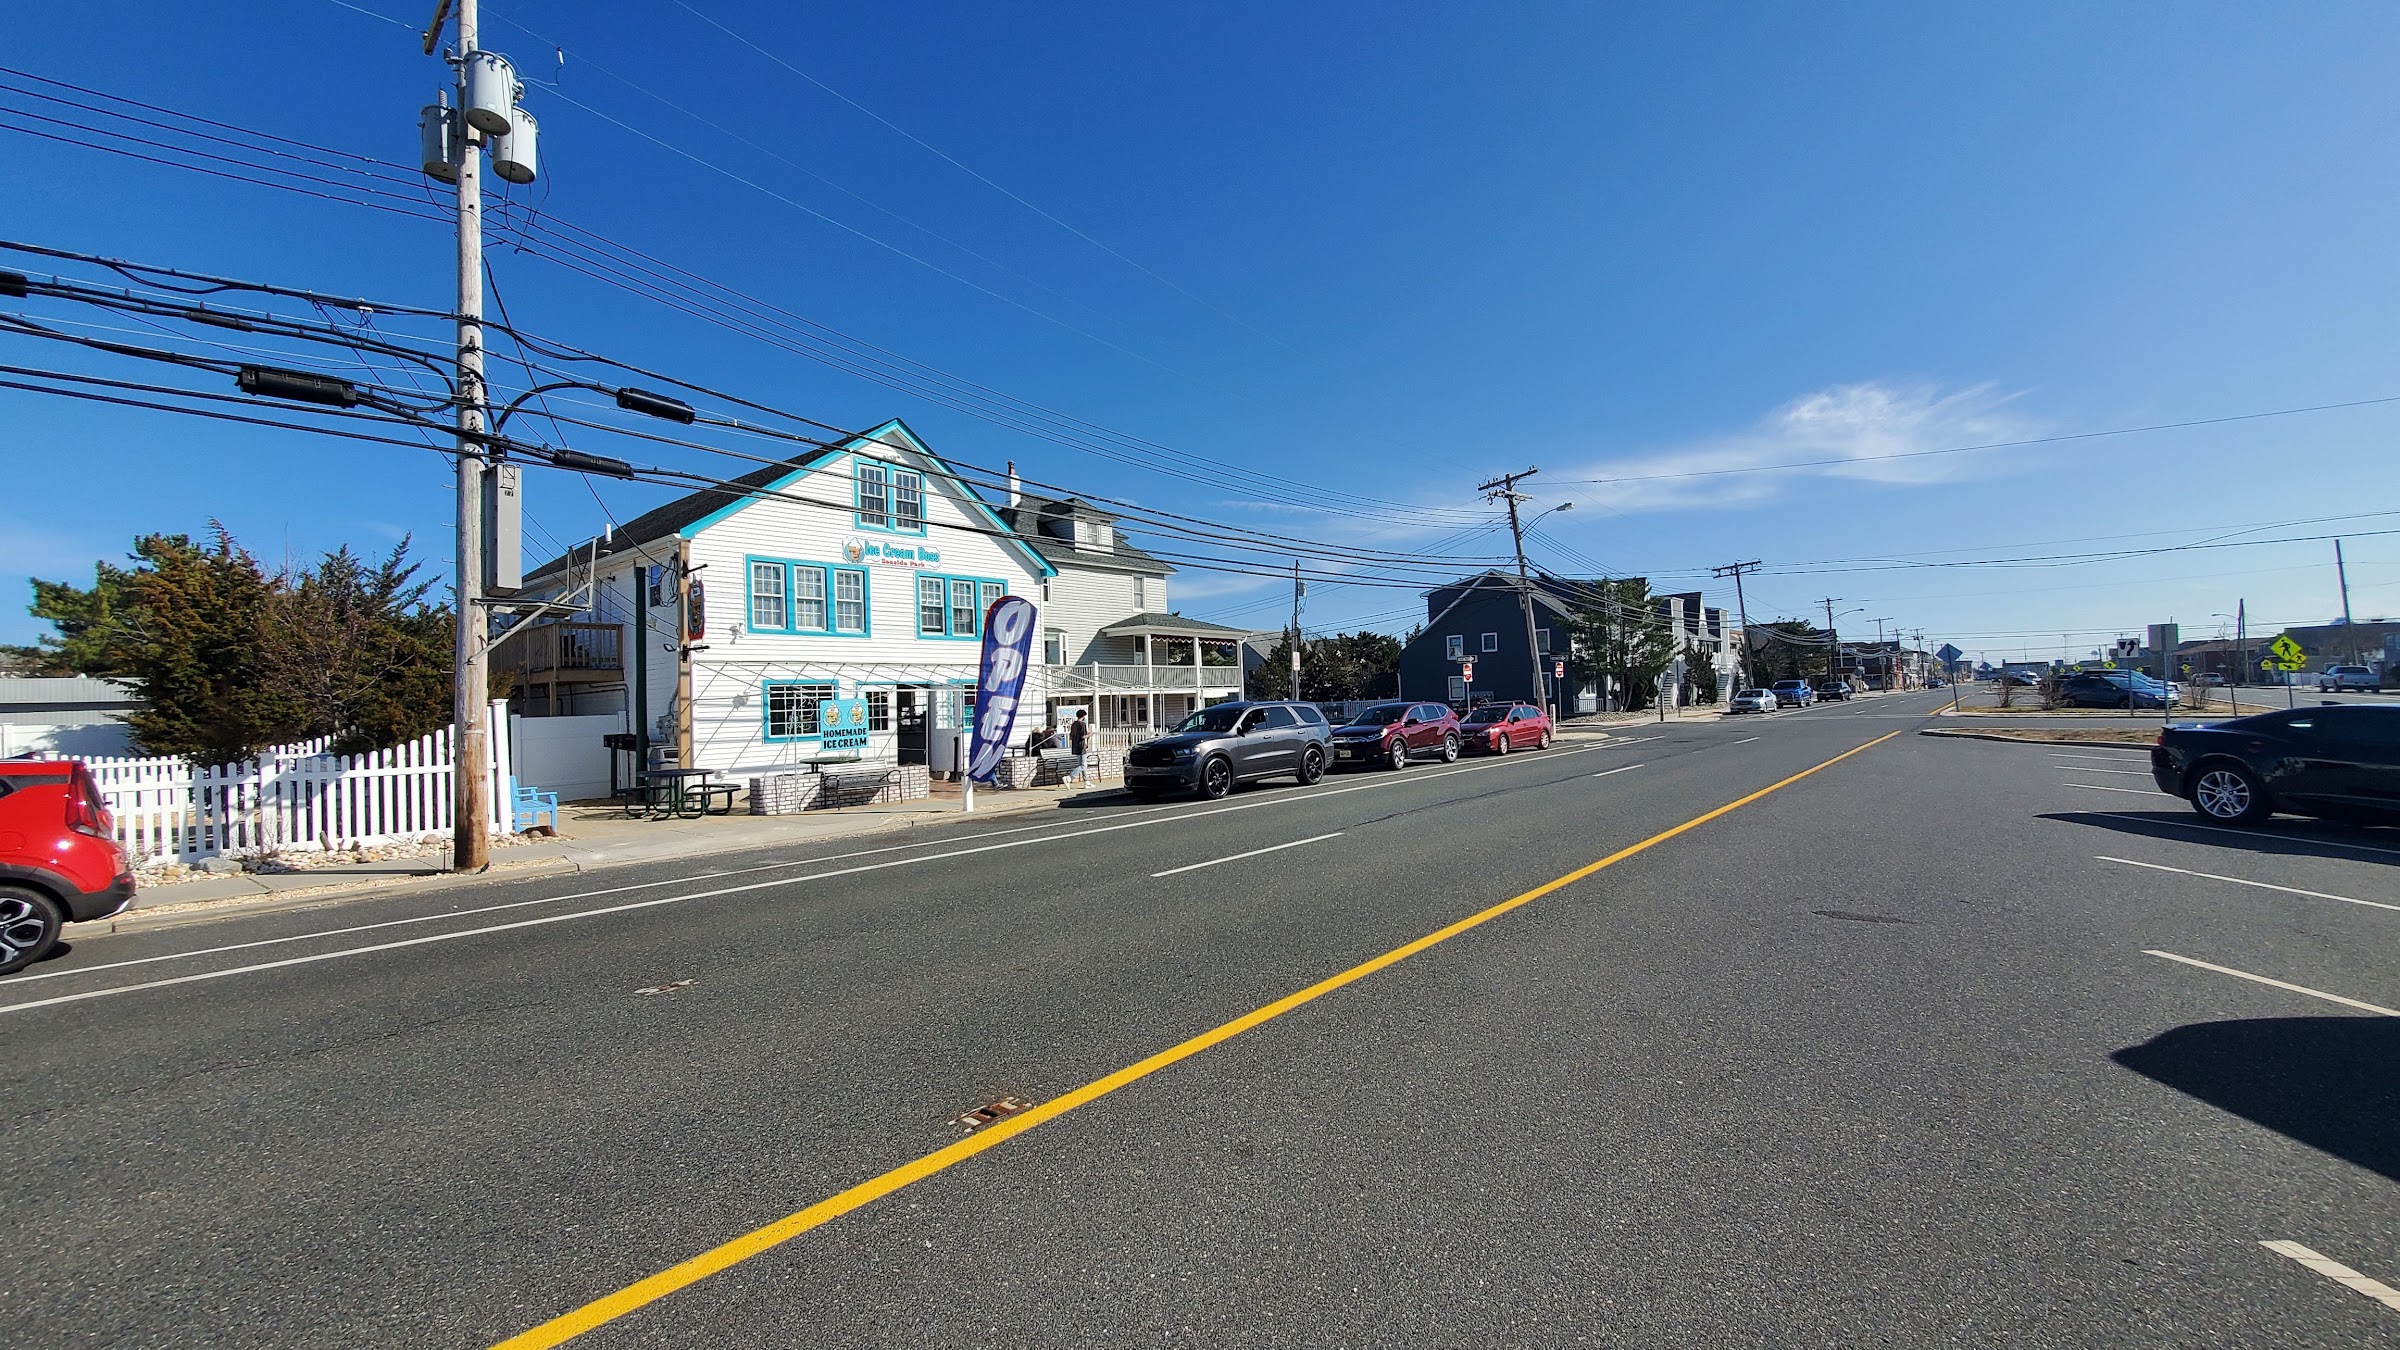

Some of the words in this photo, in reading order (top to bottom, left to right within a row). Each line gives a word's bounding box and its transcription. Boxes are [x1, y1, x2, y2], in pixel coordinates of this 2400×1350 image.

[864, 540, 880, 556] Ice
[883, 543, 914, 560] Cream
[918, 546, 940, 562] Boss
[967, 600, 1031, 779] OPEN
[823, 727, 867, 738] HOMEMADE
[823, 739, 837, 749] ICE
[838, 737, 867, 748] CREAM
